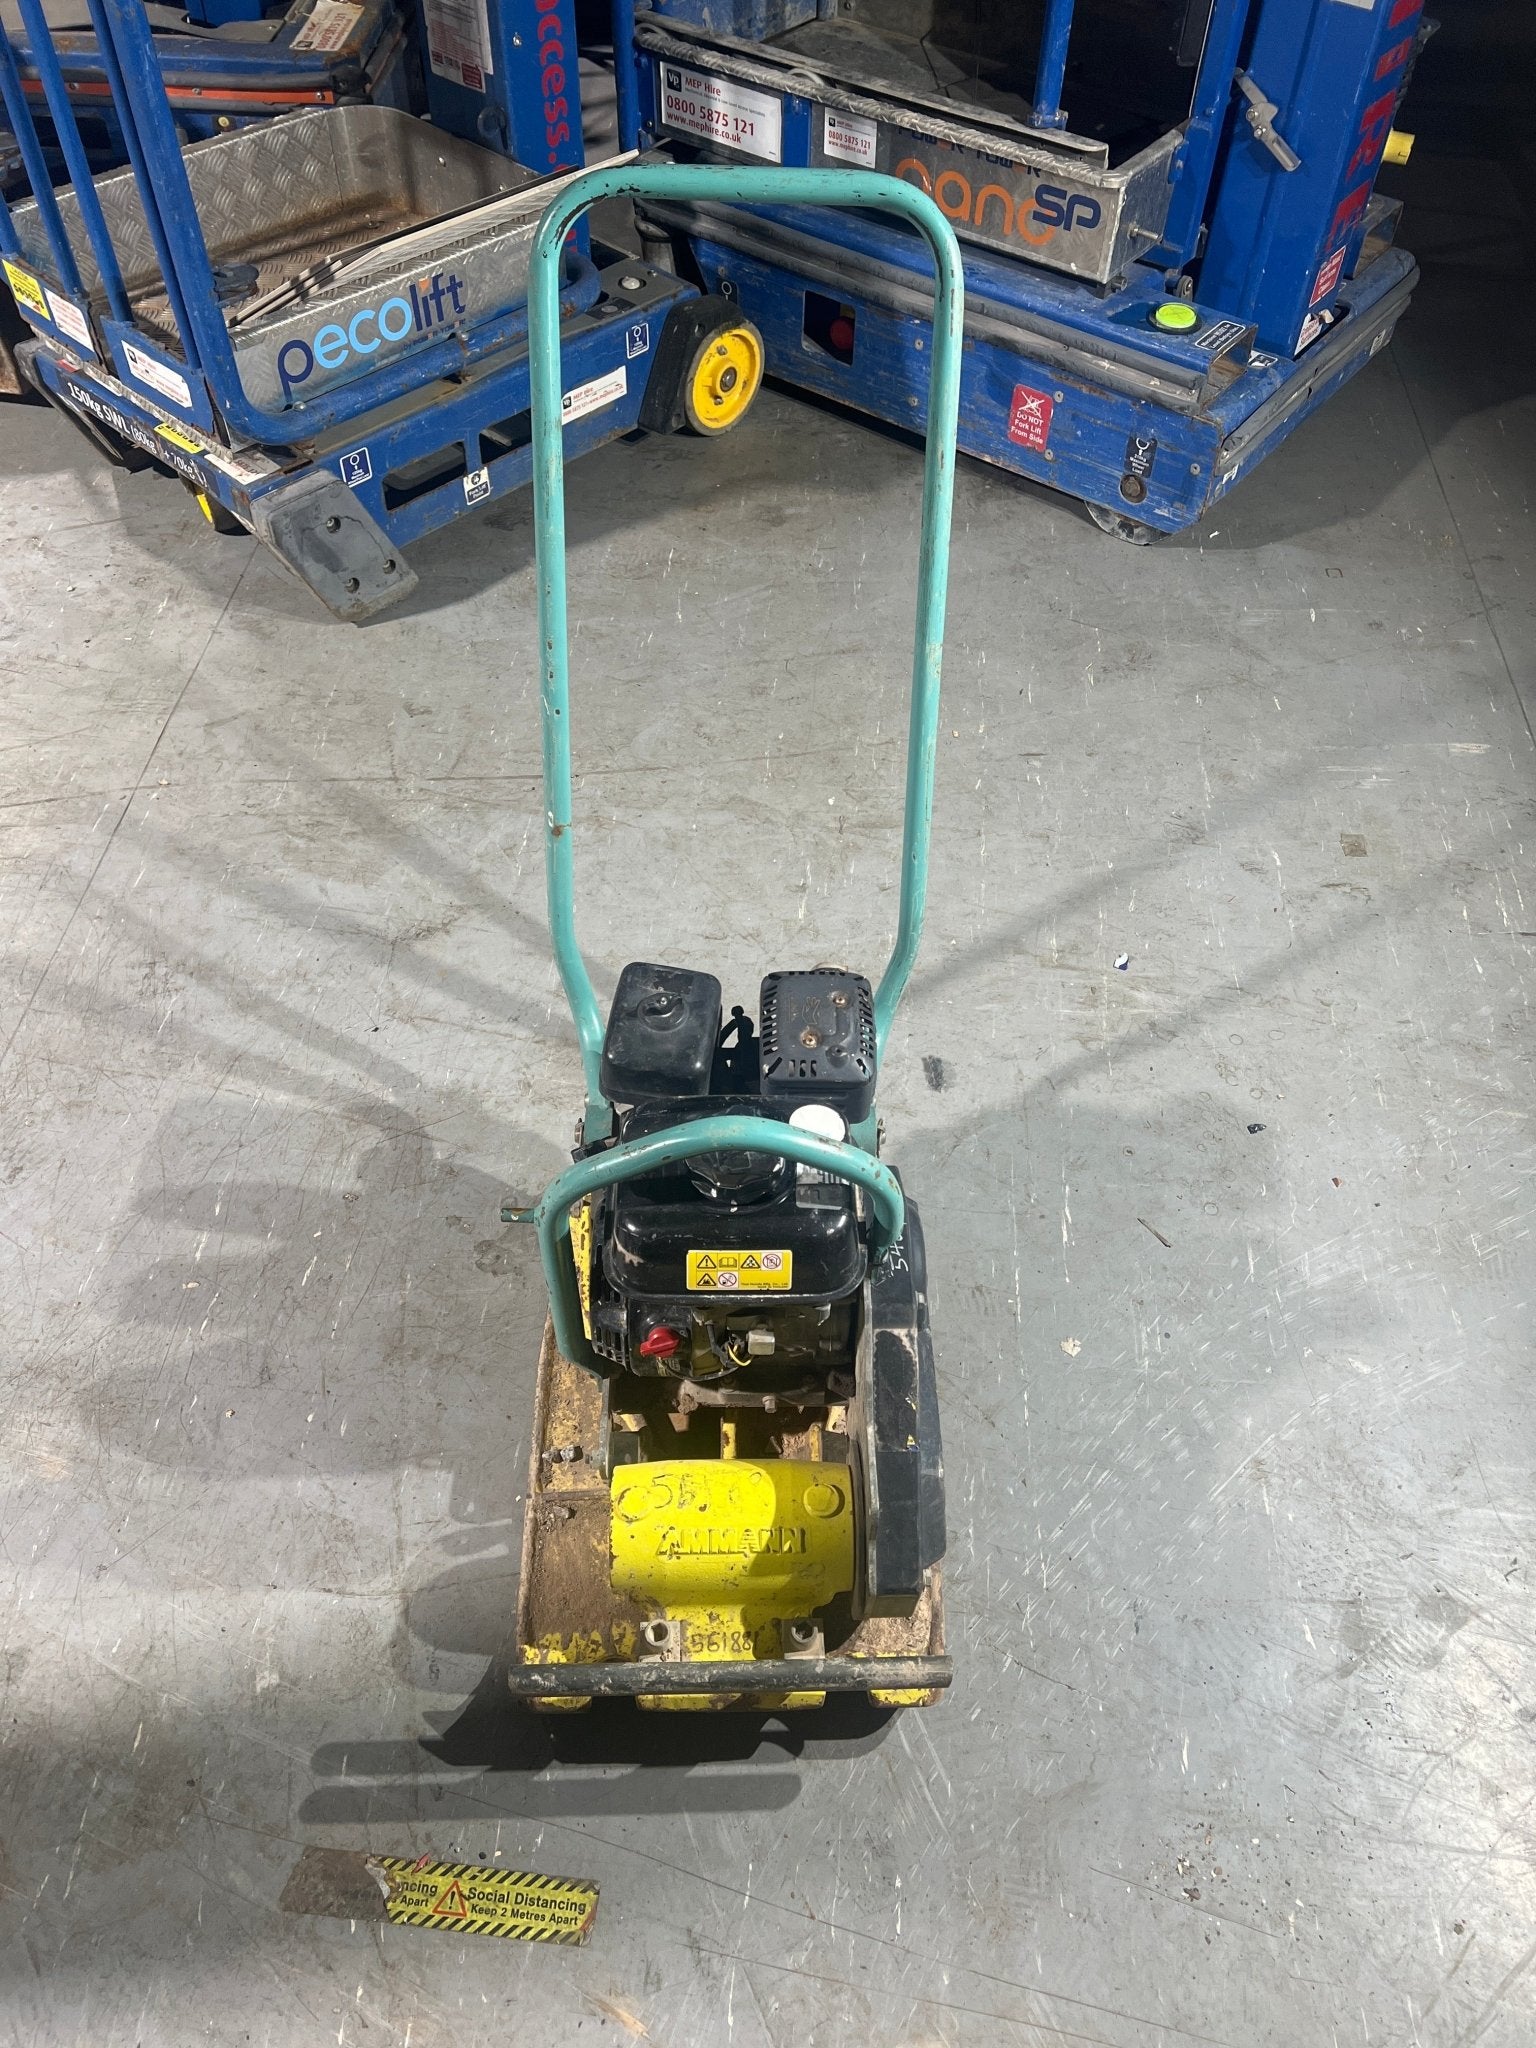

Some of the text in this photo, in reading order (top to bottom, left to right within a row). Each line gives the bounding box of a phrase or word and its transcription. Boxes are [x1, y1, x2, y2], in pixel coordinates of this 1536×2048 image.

[668, 72, 679, 86] Vp
[685, 77, 721, 96] MEP Hire
[667, 95, 754, 136] 0800 5875 121
[667, 112, 741, 144] www.mephire.co.uk
[828, 130, 843, 141] 0800
[844, 135, 859, 146] 5875
[860, 139, 871, 149] 121
[277, 273, 467, 401] pecolift
[67, 382, 103, 419] 150kg
[102, 403, 131, 434] SWL
[1014, 419, 1042, 436] Fork Lift
[1017, 411, 1044, 427] DO NOT
[1011, 426, 1043, 444] From Side
[656, 1527, 807, 1554] AMMANN
[400, 1894, 429, 1907] Apart
[467, 1886, 587, 1915] Social Distancing
[470, 1903, 579, 1926] Keep 2 Metres Apart
